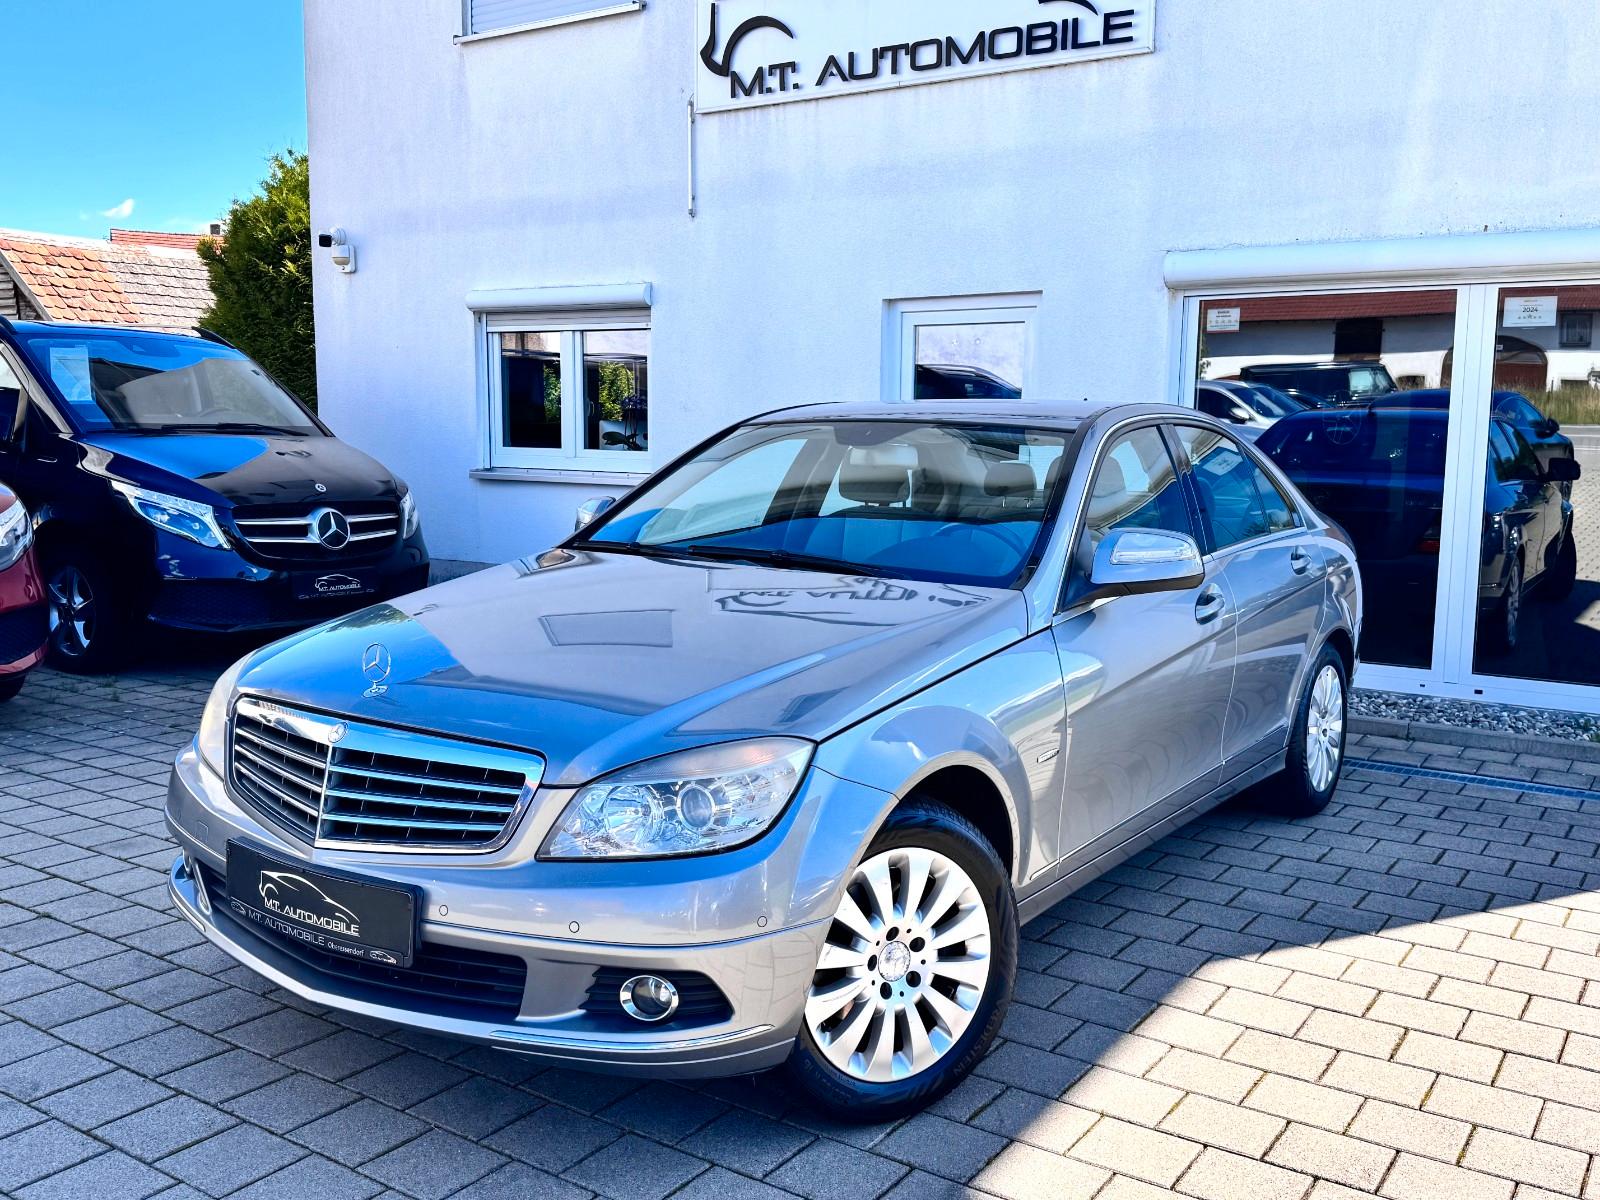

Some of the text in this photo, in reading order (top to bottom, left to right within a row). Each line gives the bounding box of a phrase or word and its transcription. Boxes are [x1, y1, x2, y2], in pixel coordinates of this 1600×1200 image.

[731, 10, 1135, 98] M.T. AUTOMOBILE
[248, 910, 262, 922] M.T.
[265, 918, 325, 946] AUTOMOBILE
[264, 897, 360, 934] M.T. AUTOMOBILE
